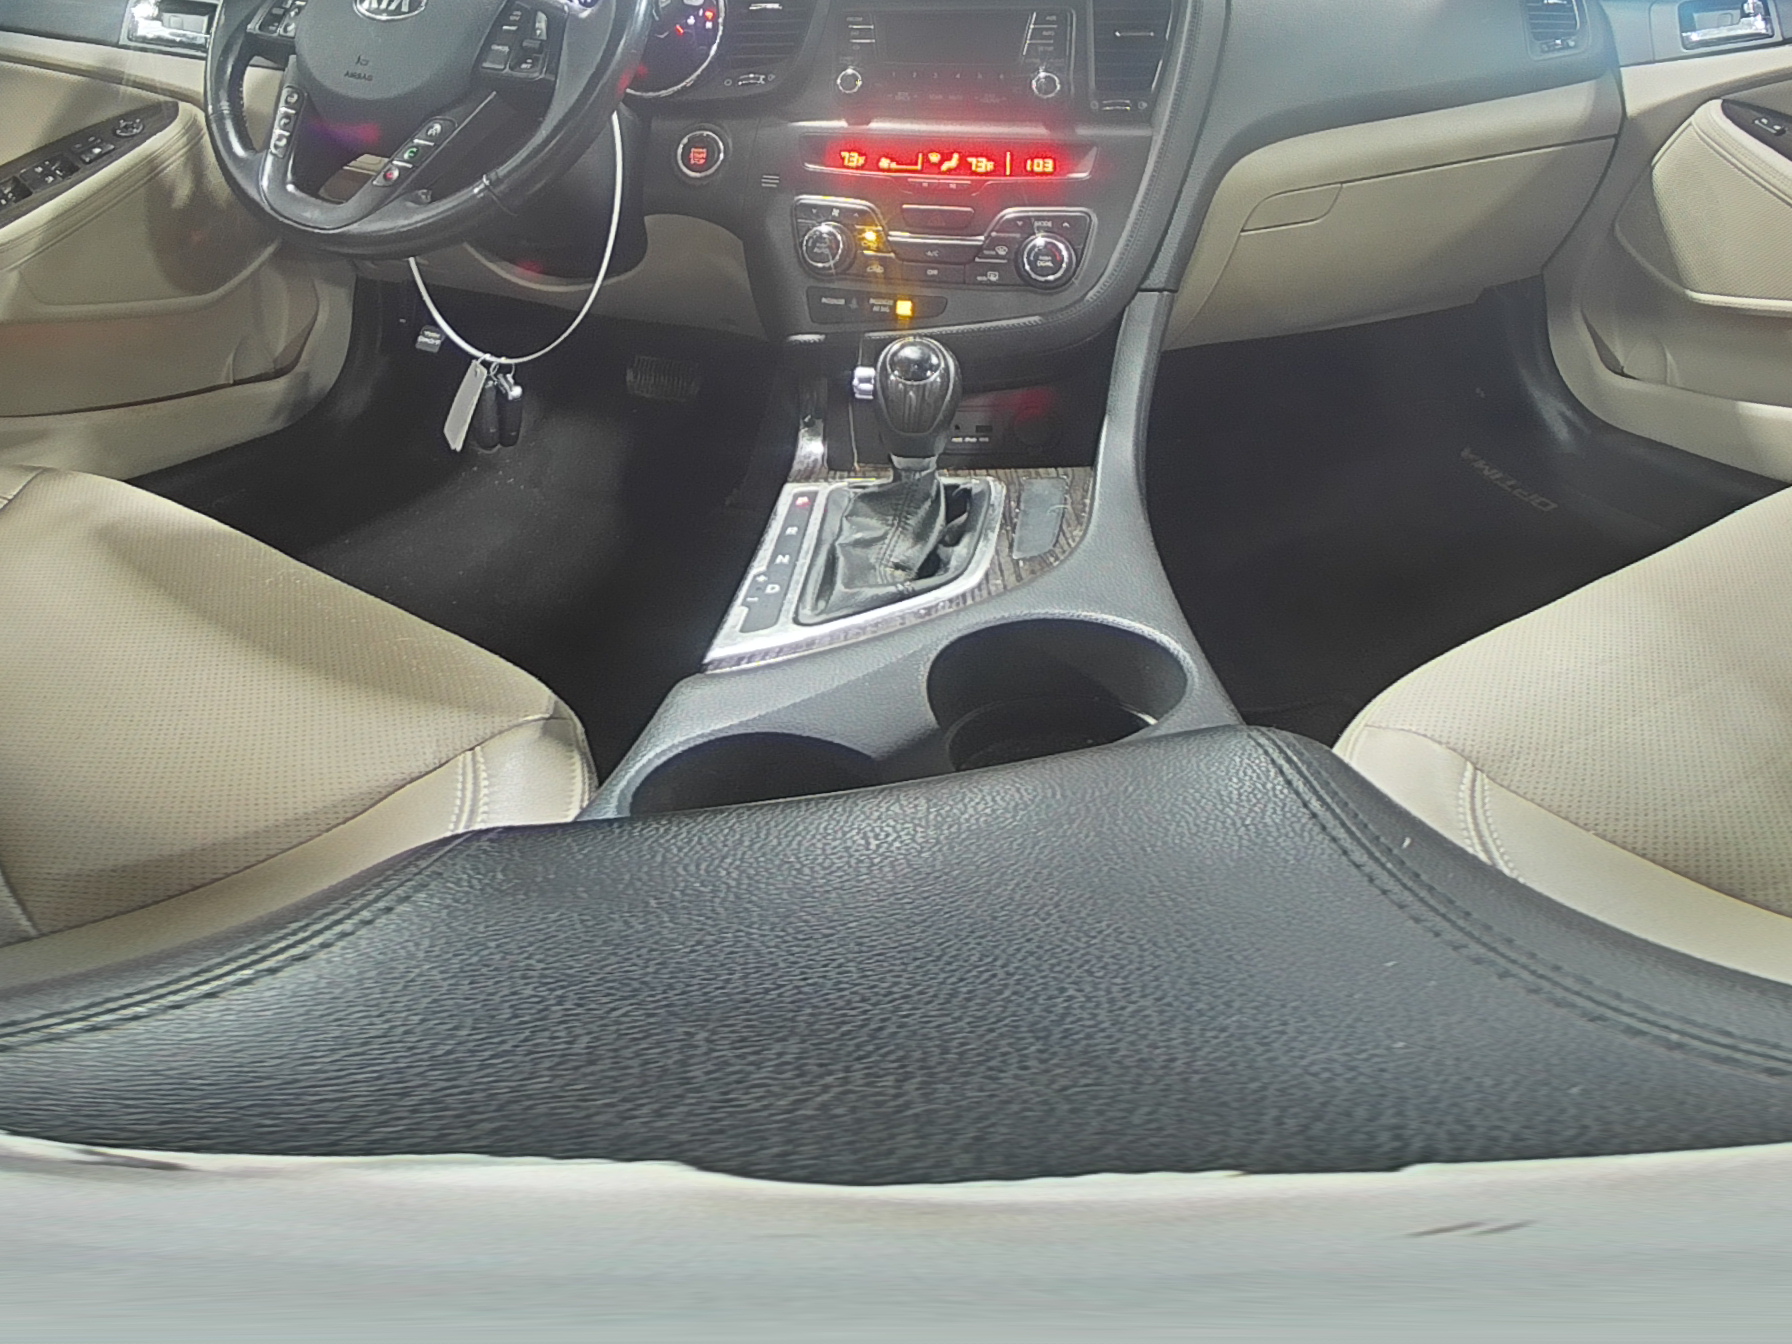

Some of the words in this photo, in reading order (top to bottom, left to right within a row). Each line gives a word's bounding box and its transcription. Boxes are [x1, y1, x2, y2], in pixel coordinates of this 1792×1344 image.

[343, 70, 374, 82] AIRBAG
[1460, 445, 1559, 513] OPTIMA
[785, 526, 799, 535] R
[774, 554, 790, 565] N
[764, 584, 781, 594] D
